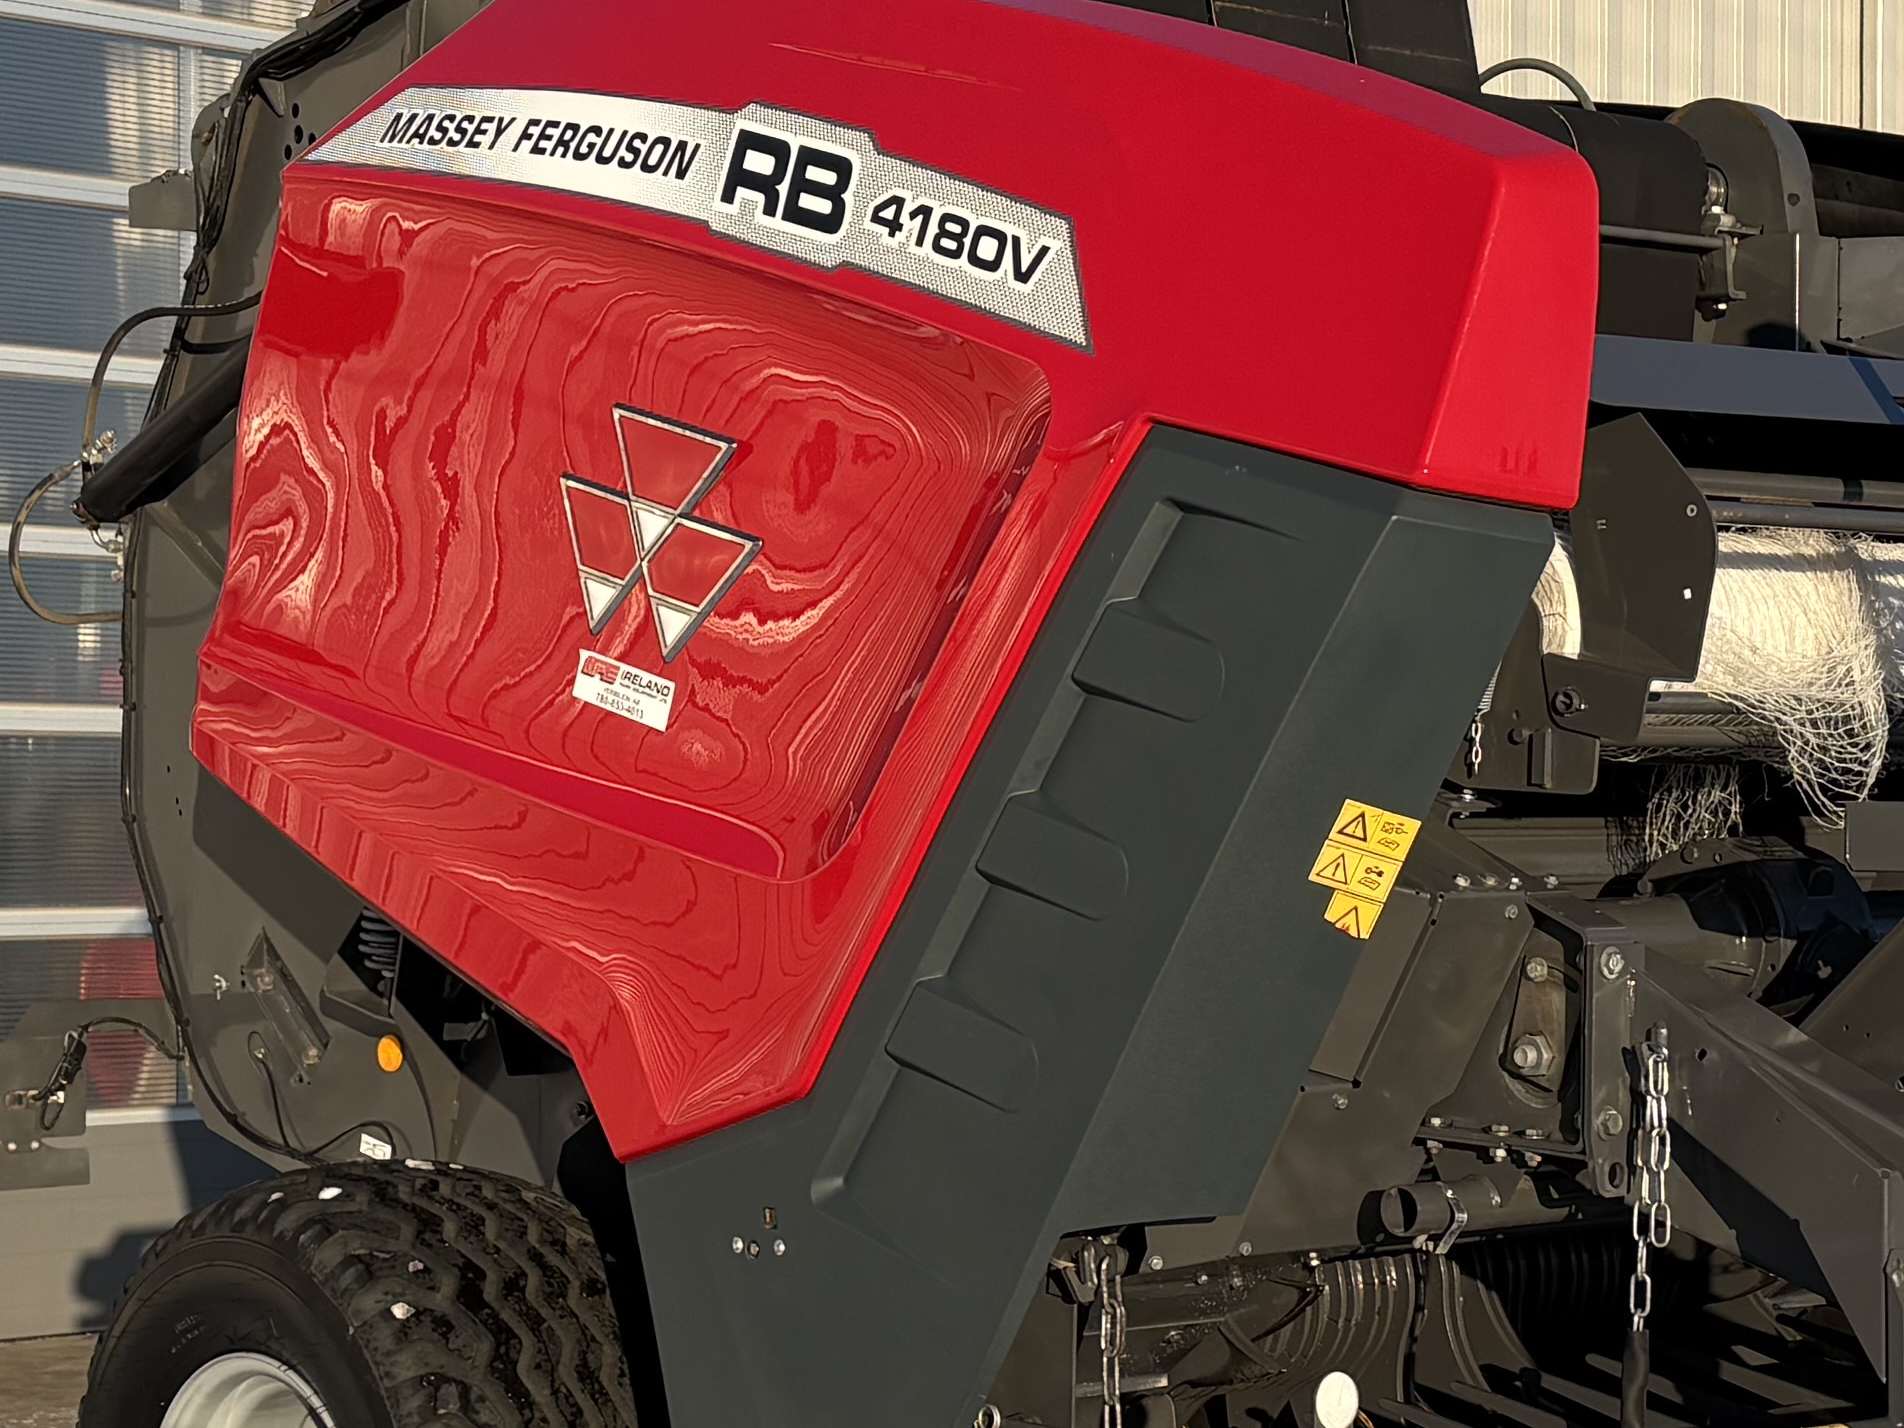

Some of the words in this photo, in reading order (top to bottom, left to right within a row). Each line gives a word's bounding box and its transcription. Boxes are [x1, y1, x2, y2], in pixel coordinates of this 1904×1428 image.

[379, 111, 517, 151] MASSEY
[513, 118, 702, 180] FERGUSON
[720, 128, 853, 235] RB
[869, 194, 1052, 285] 4180V
[620, 670, 671, 697] IRELAND
